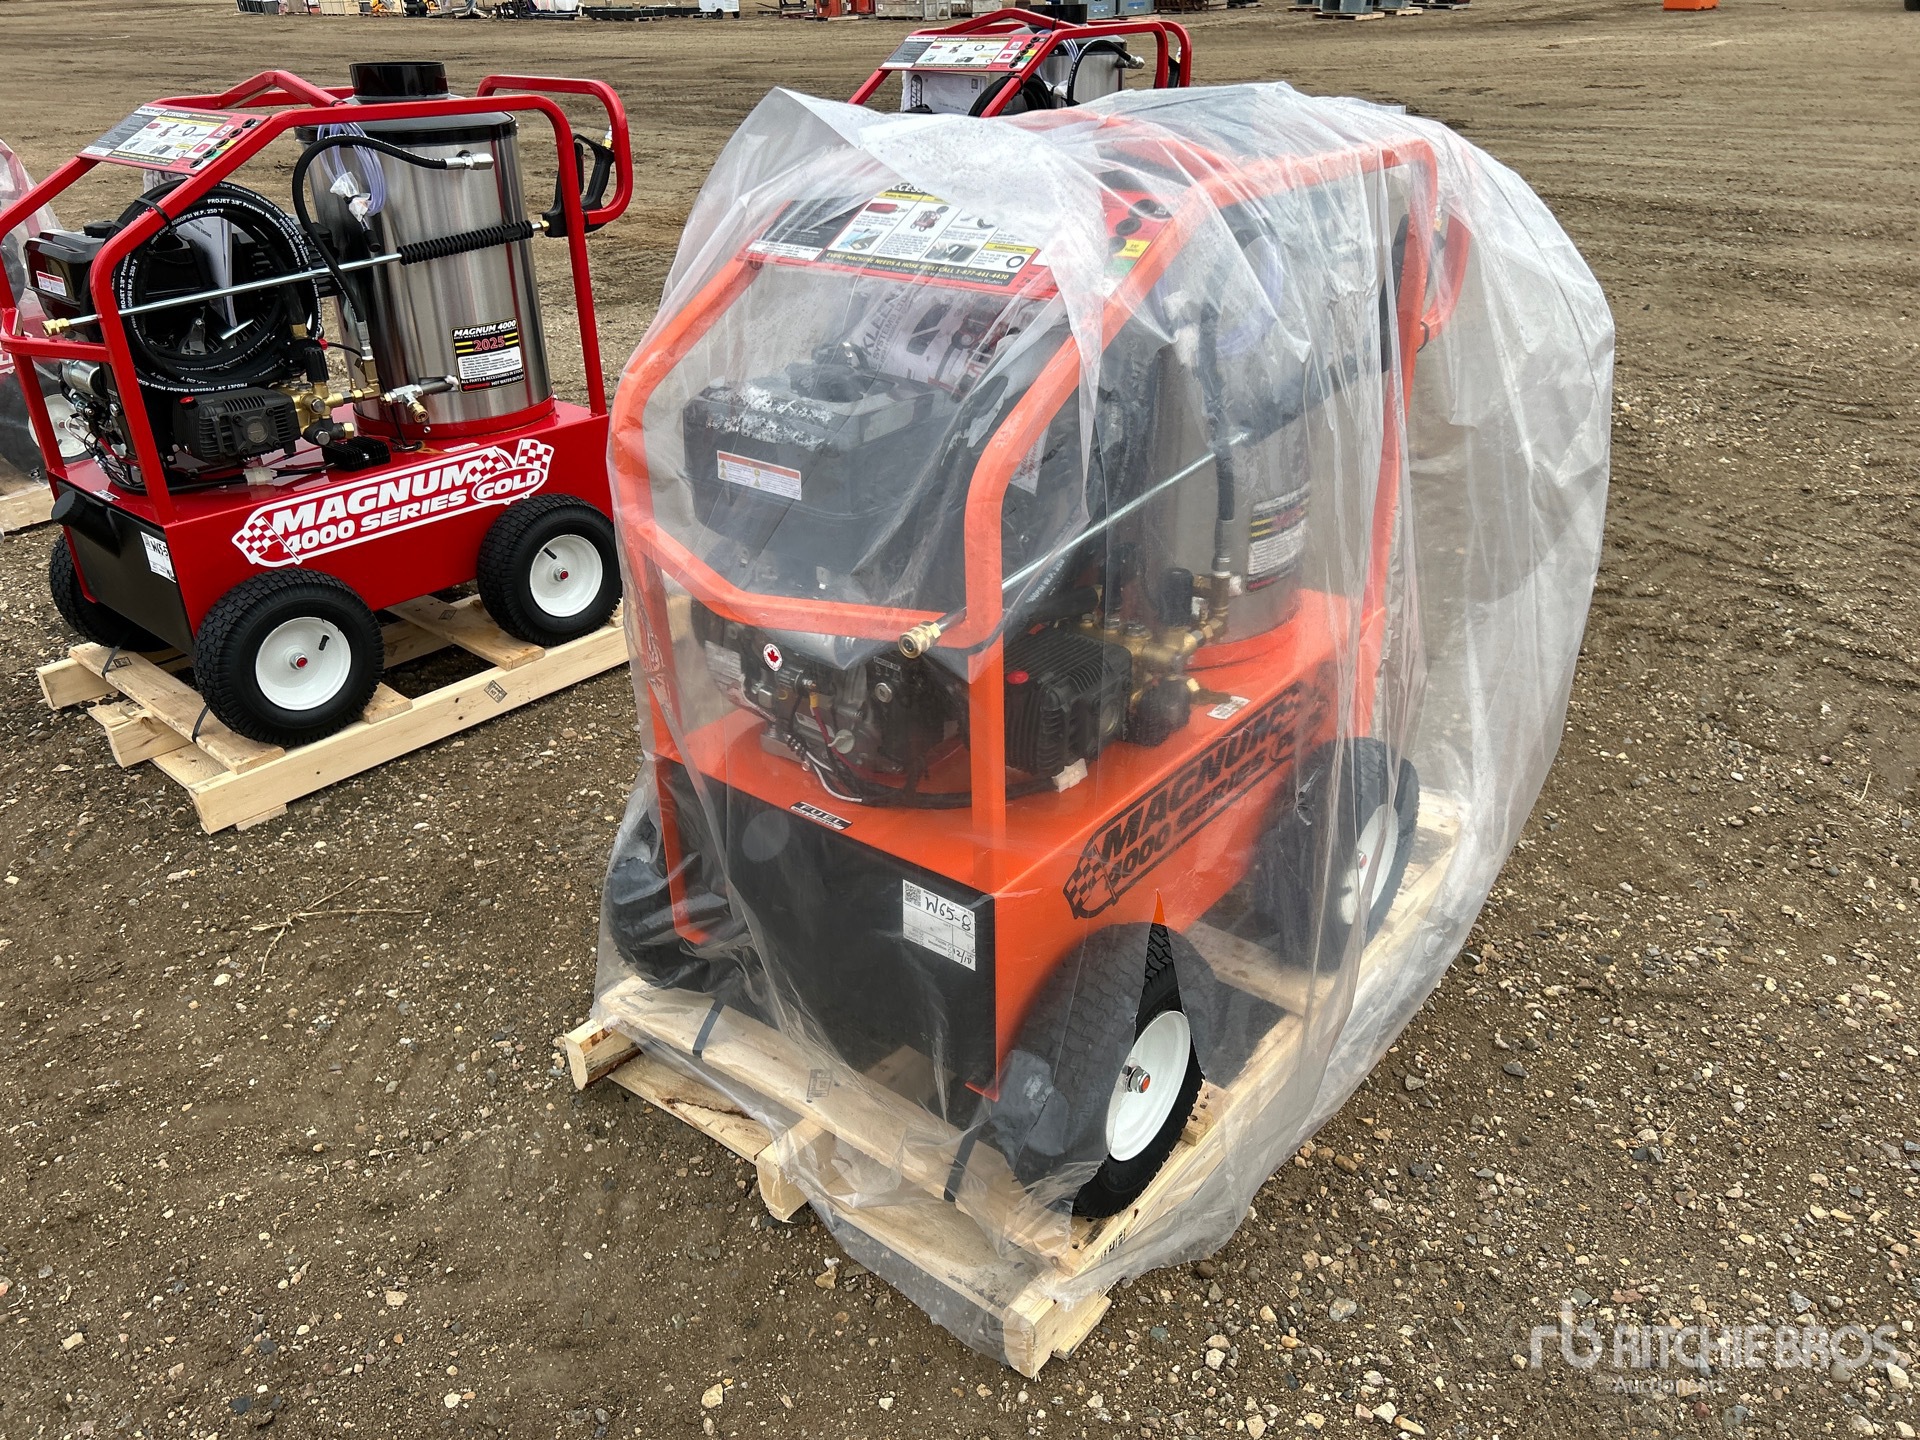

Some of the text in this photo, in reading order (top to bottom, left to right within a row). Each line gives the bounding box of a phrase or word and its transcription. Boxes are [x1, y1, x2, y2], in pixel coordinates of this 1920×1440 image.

[826, 252, 849, 261] EVERY
[846, 255, 873, 264] MACHINE
[874, 257, 894, 267] NEEDS
[902, 261, 919, 269] HOSE
[938, 266, 955, 274] CALL
[955, 268, 1009, 280] 1-877-441-4430
[454, 320, 517, 337] MAGNUM 4000
[473, 336, 506, 352] 2025
[270, 461, 484, 536] MAGNUM
[475, 471, 540, 500] GOLD
[283, 489, 467, 553] 4000 SERIES
[1100, 710, 1280, 862] MAGNUM
[800, 804, 843, 825] FUEL
[1106, 750, 1267, 888] 4000 SERIES
[925, 896, 972, 932] W65-8
